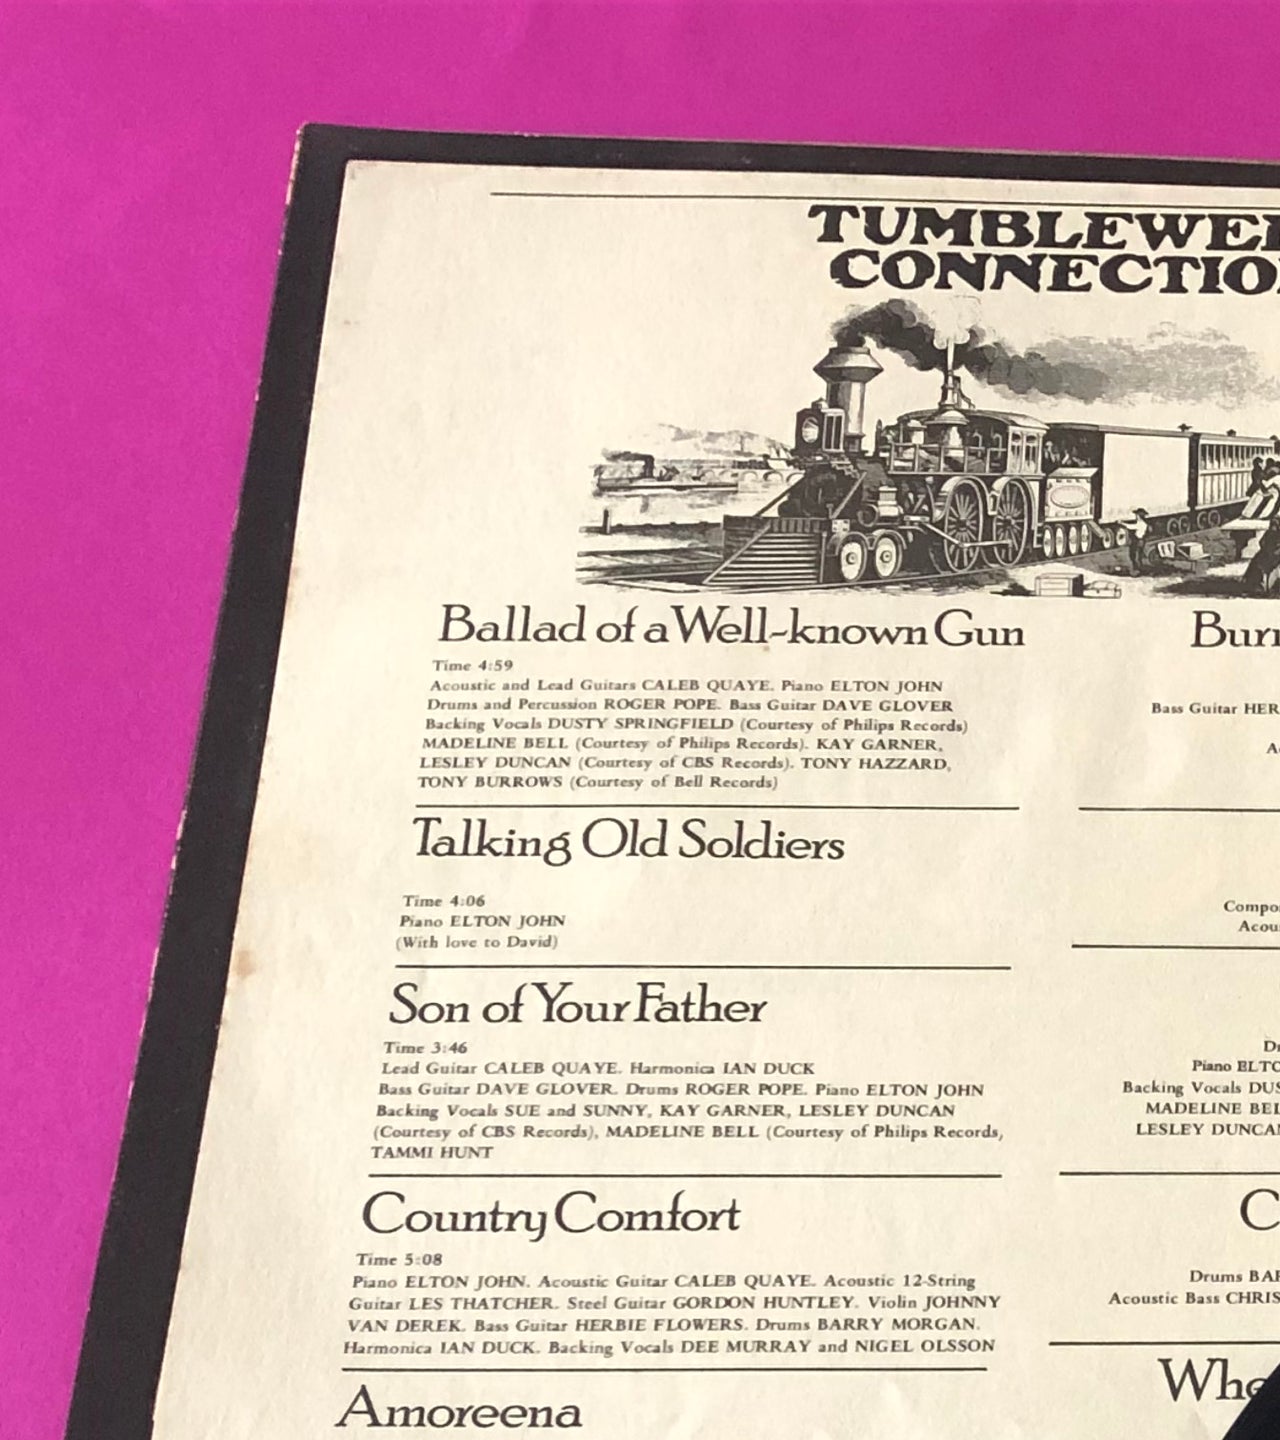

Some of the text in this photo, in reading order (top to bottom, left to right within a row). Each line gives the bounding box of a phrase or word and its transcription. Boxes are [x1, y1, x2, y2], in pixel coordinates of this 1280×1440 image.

[437, 603, 1027, 649] Ballad of a Well-known Gun
[429, 677, 943, 696] Acoustic and Lead Guitars CALEB QUAYE. Piano ELTON JOHN
[431, 659, 514, 672] Time 4:59
[412, 816, 846, 868] Talking Old Soldiers
[395, 934, 559, 952] (With love to David)
[388, 981, 769, 1025] Son of Your Father
[381, 1060, 816, 1078] Lead Guitar CALEB QUAYE. Harmonica IAN DUCK
[361, 1189, 742, 1243] Country Comfort
[1159, 1358, 1267, 1401] Whe
[333, 1383, 584, 1429] Amoreena
